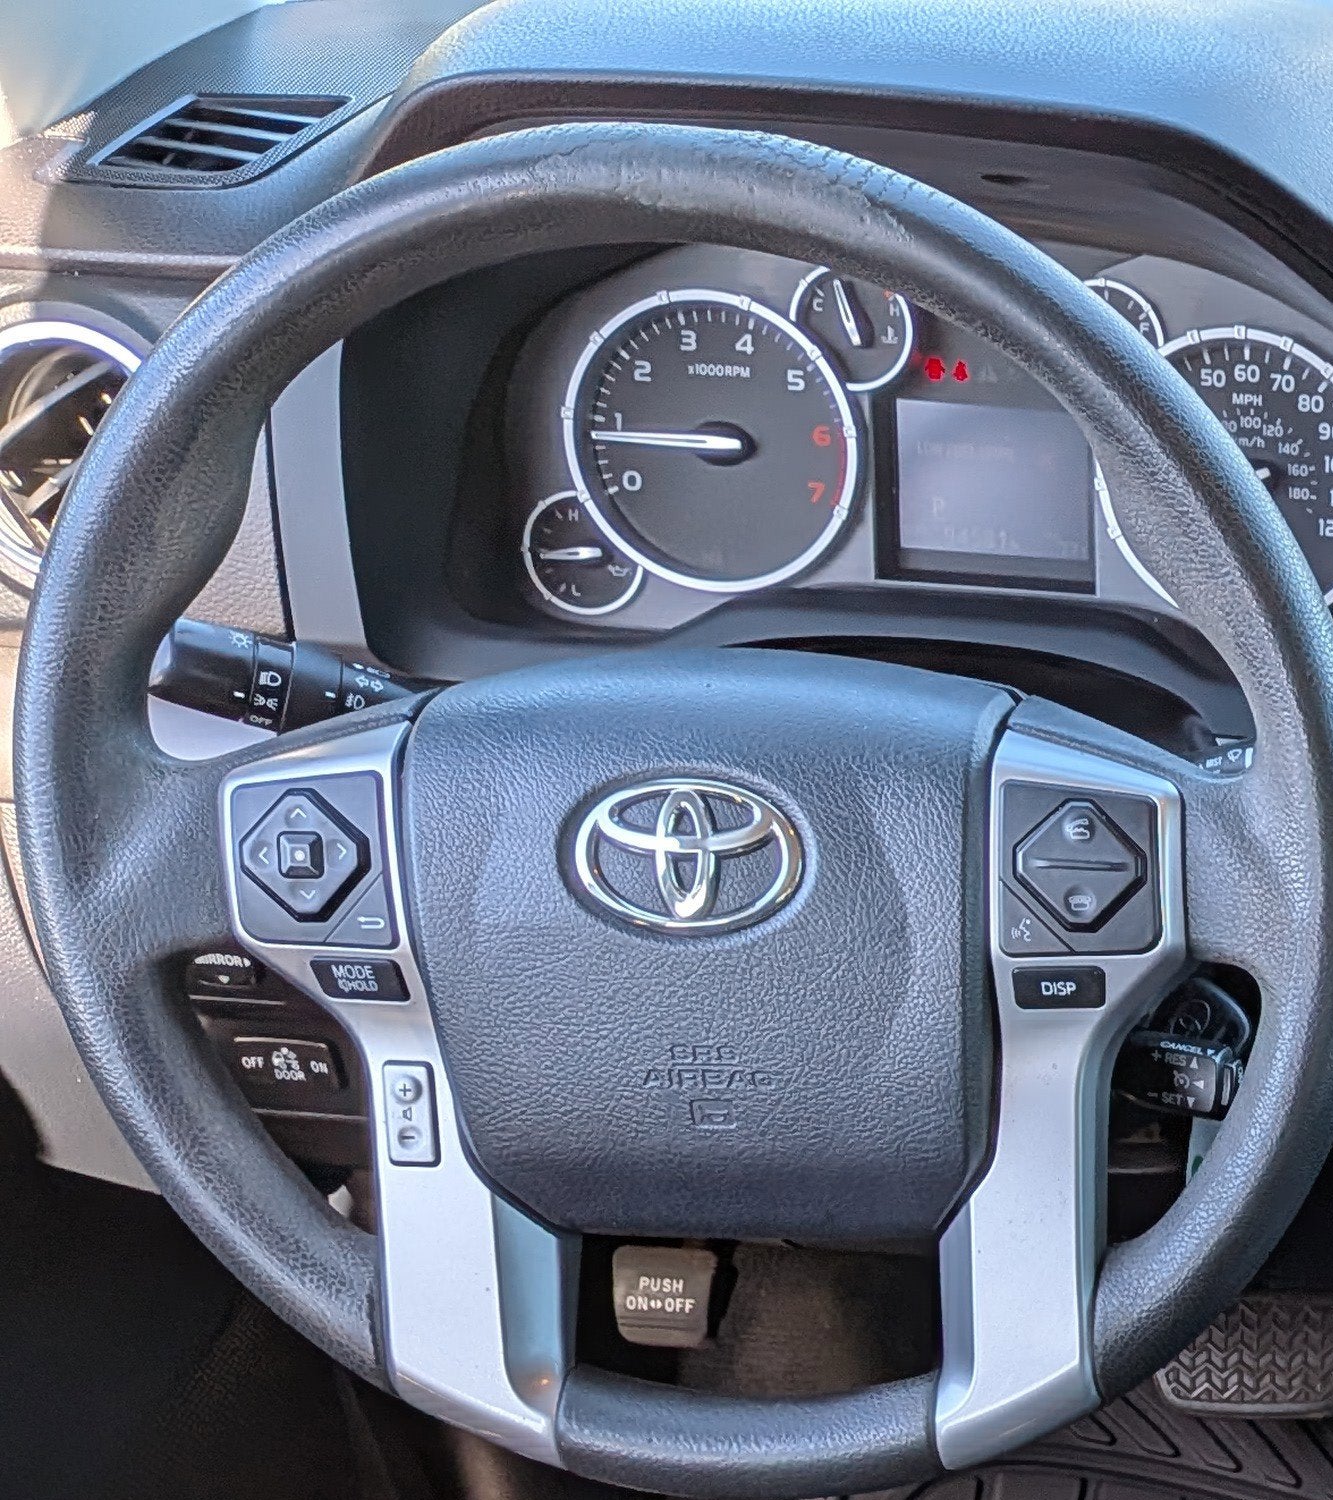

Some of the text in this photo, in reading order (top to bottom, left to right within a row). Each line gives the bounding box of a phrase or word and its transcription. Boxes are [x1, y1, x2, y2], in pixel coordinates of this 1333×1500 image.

[812, 299, 823, 312] C
[889, 303, 900, 316] H
[680, 330, 697, 351] 3
[735, 334, 754, 355] 4
[634, 360, 652, 382] 2
[1200, 368, 1226, 388] 50
[1234, 364, 1260, 383] 60
[787, 369, 805, 391] 5
[1270, 373, 1295, 392] 70
[1232, 393, 1263, 407] MPH
[1298, 394, 1324, 413] 80
[614, 412, 622, 431] 1
[1240, 415, 1262, 429] 100
[812, 425, 831, 446] 6
[1262, 424, 1284, 438] 120
[1278, 442, 1299, 455] 140
[1287, 464, 1308, 477] 160
[622, 470, 642, 492] 0
[808, 480, 826, 503] 7
[1288, 487, 1310, 501] 180
[568, 508, 579, 521] H
[571, 584, 581, 597] L
[250, 714, 273, 726] OFF
[331, 965, 375, 980] MODE
[1041, 982, 1077, 996] DISP
[1160, 1041, 1203, 1055] CANCEL
[241, 1056, 264, 1070] OFF
[1165, 1052, 1187, 1067] RES
[310, 1061, 329, 1074] ON
[274, 1069, 306, 1081] DOOR
[1161, 1092, 1184, 1106] SET
[639, 1276, 684, 1293] PUSH
[626, 1295, 696, 1313] ON OFF
